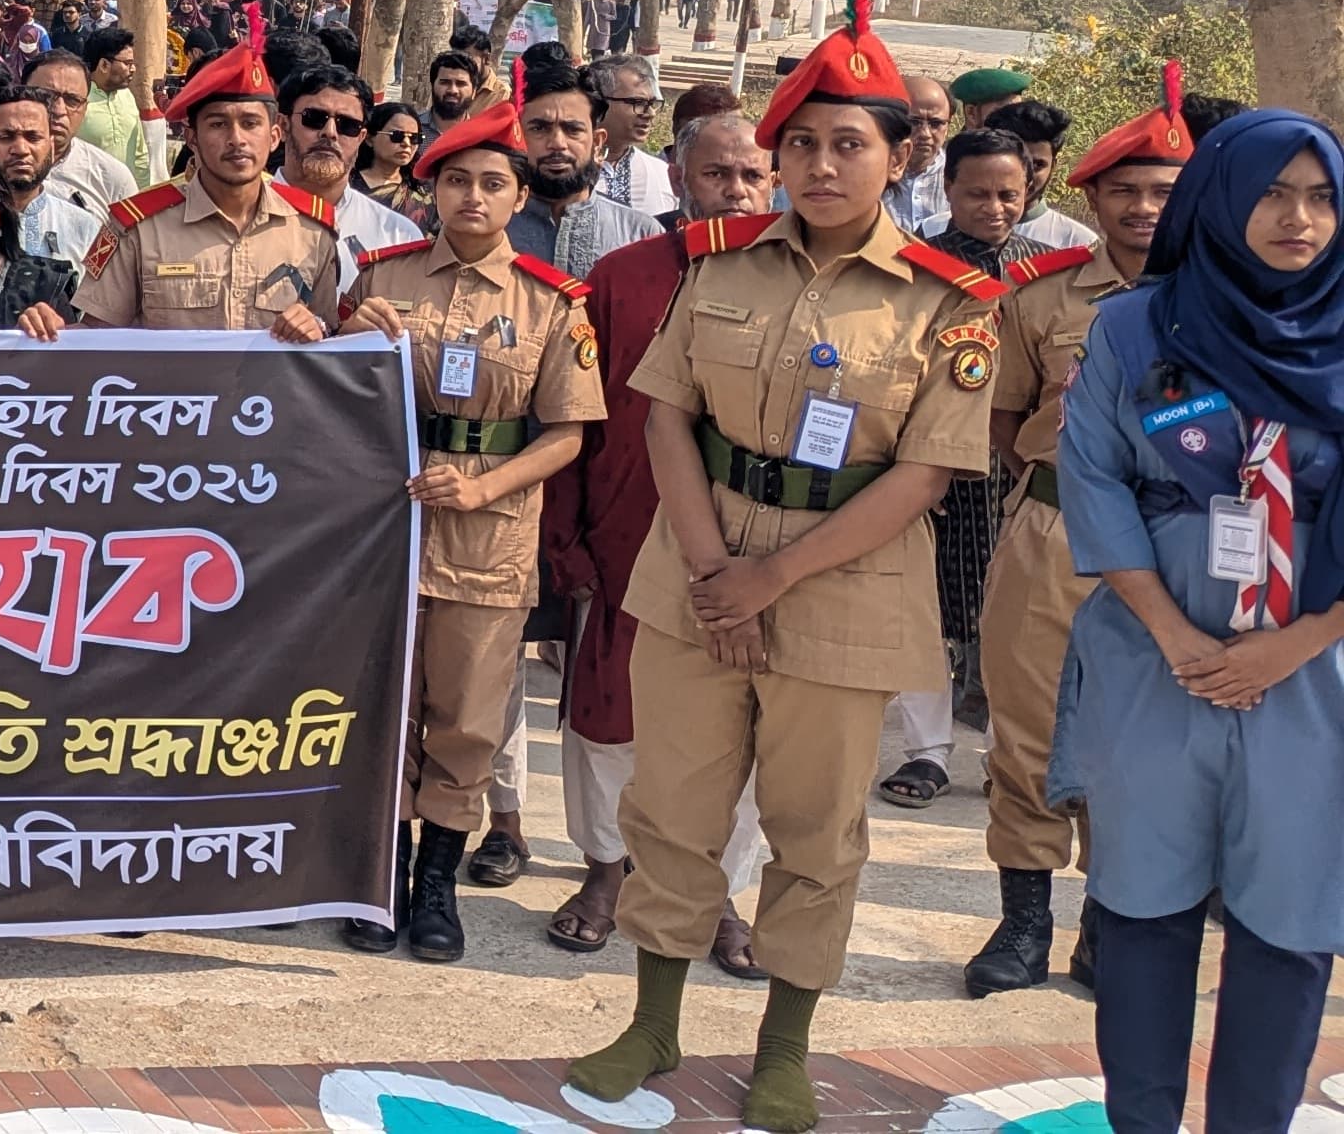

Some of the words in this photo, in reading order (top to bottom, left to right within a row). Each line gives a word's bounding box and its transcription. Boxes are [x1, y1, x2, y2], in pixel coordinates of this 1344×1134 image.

[84, 376, 218, 437] দিবস
[232, 395, 274, 436] ও
[1153, 404, 1189, 426] MOON
[0, 443, 121, 504] দিবস
[132, 463, 279, 505] ২০২৬
[63, 689, 357, 778] শ্রদ্ধাঞ্জলি
